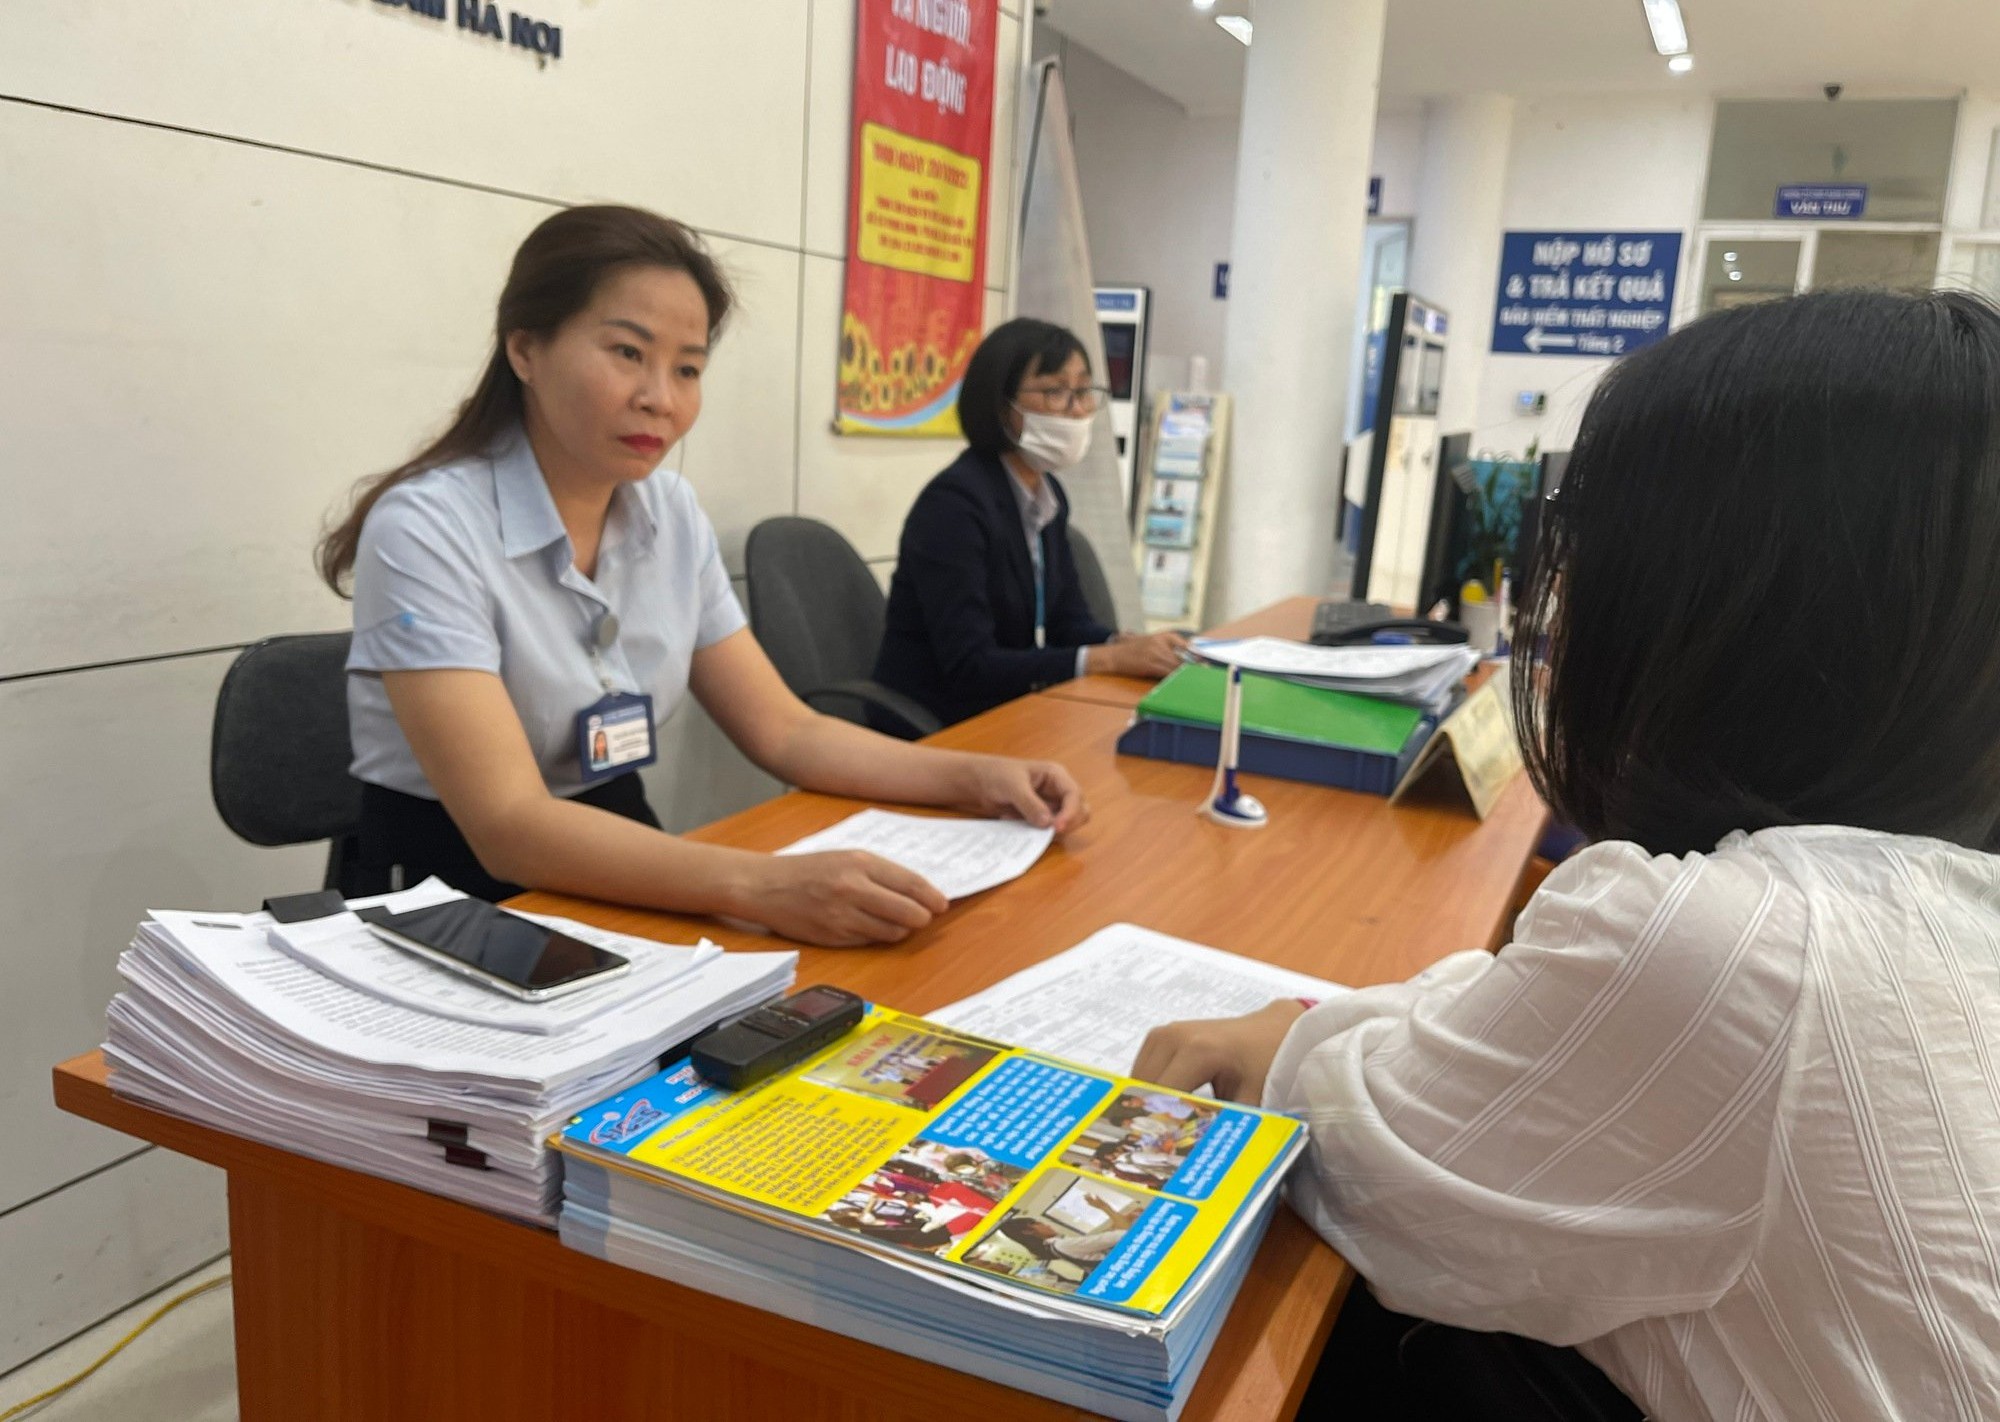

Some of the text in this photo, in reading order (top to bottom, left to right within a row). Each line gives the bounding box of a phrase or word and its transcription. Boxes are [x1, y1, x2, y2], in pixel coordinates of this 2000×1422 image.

[885, 43, 917, 95] LAO
[1532, 235, 1652, 271] NỘP HỒ SƠ
[1505, 268, 1665, 304] & TRẢ KẾT QUẢ
[1612, 335, 1626, 353] 2
